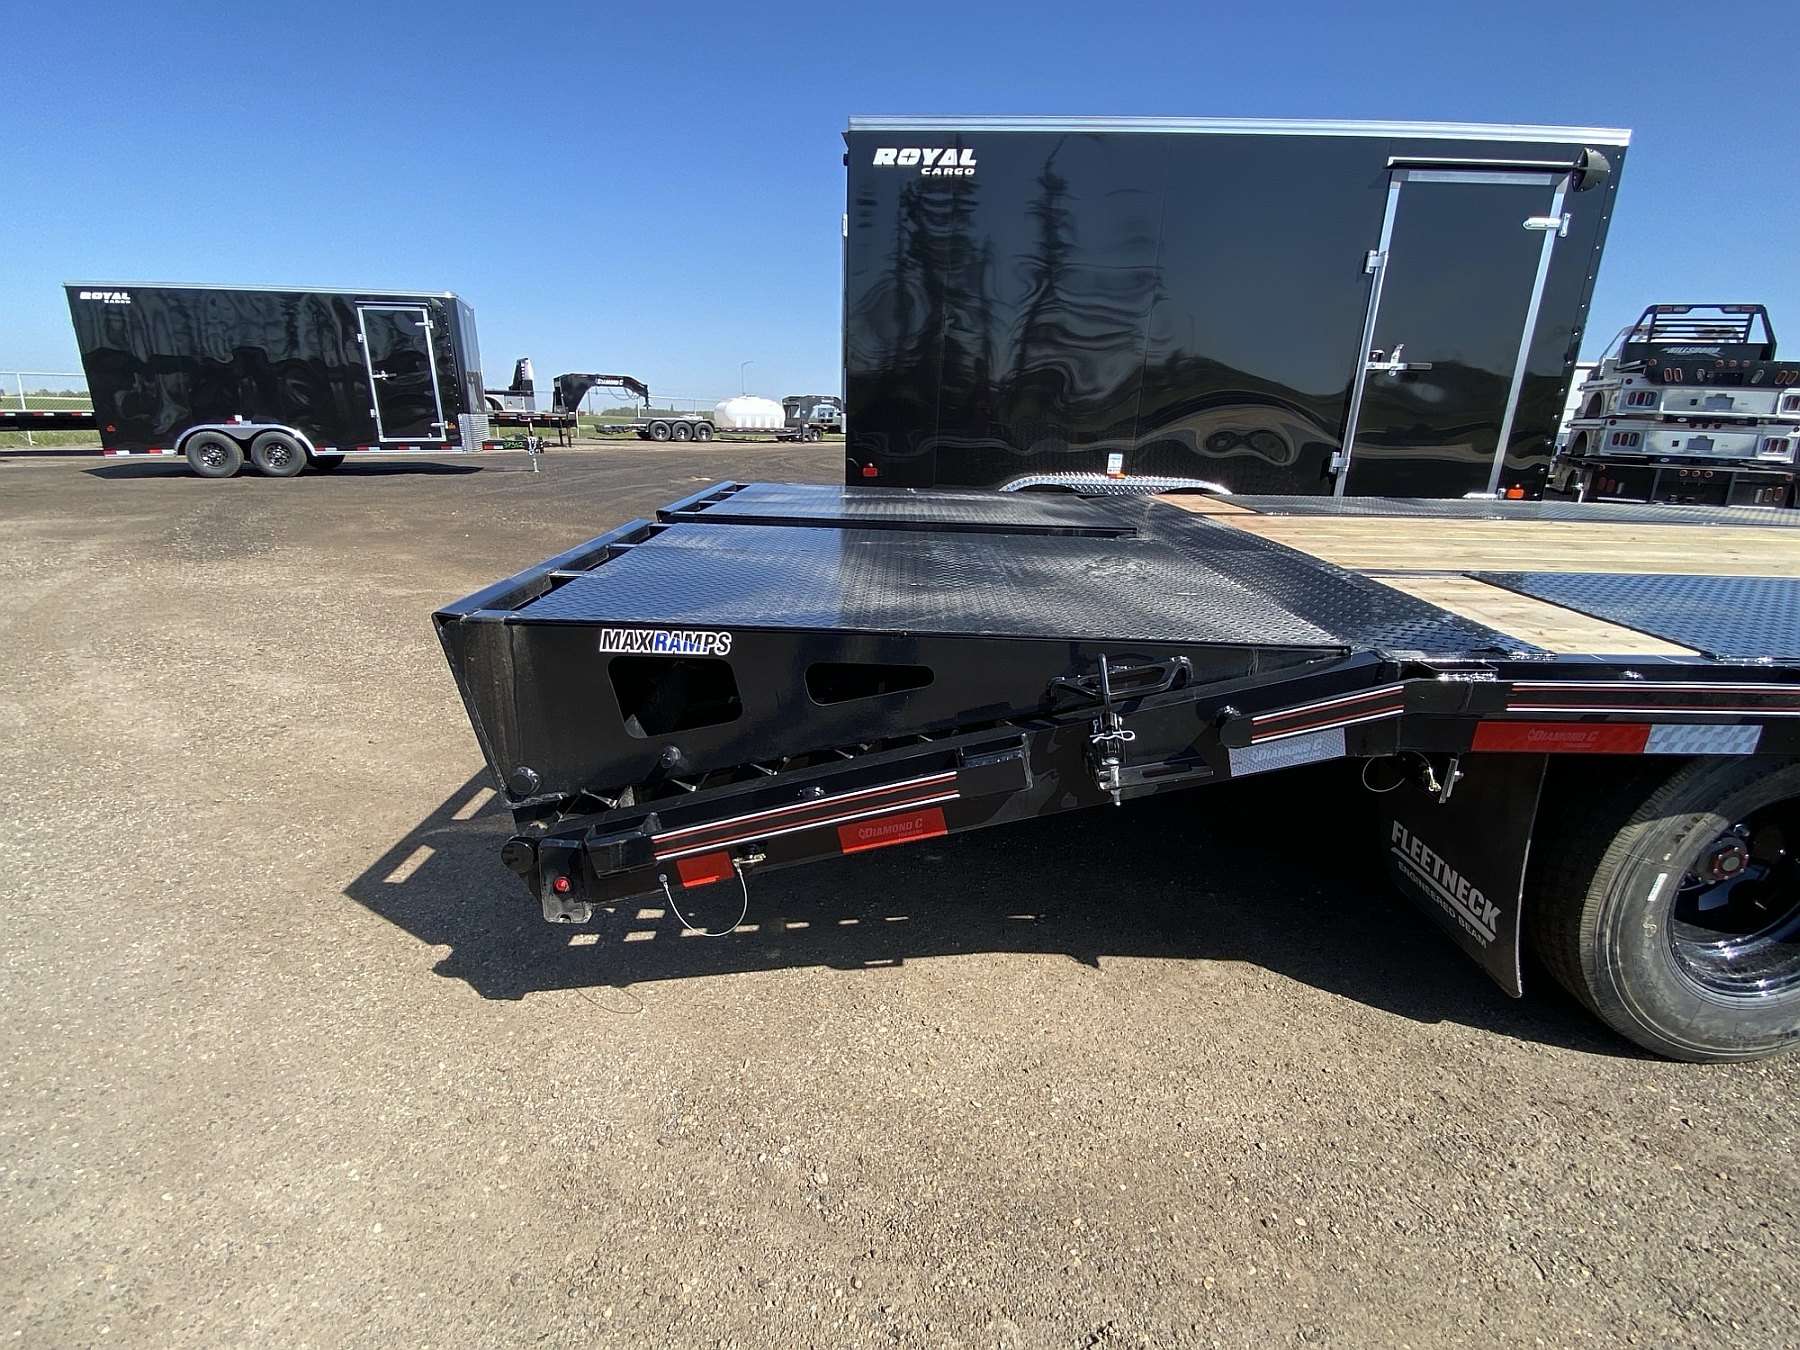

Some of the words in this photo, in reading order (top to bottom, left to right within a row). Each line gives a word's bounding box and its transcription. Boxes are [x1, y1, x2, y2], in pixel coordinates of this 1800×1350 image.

[872, 148, 977, 166] ROYAL
[921, 167, 975, 176] CARGO
[80, 291, 130, 300] ROYAL
[865, 821, 913, 838] DIAMOND
[914, 818, 923, 829] C
[1391, 820, 1501, 933] FLEETNECK
[1458, 915, 1487, 948] BEAM
